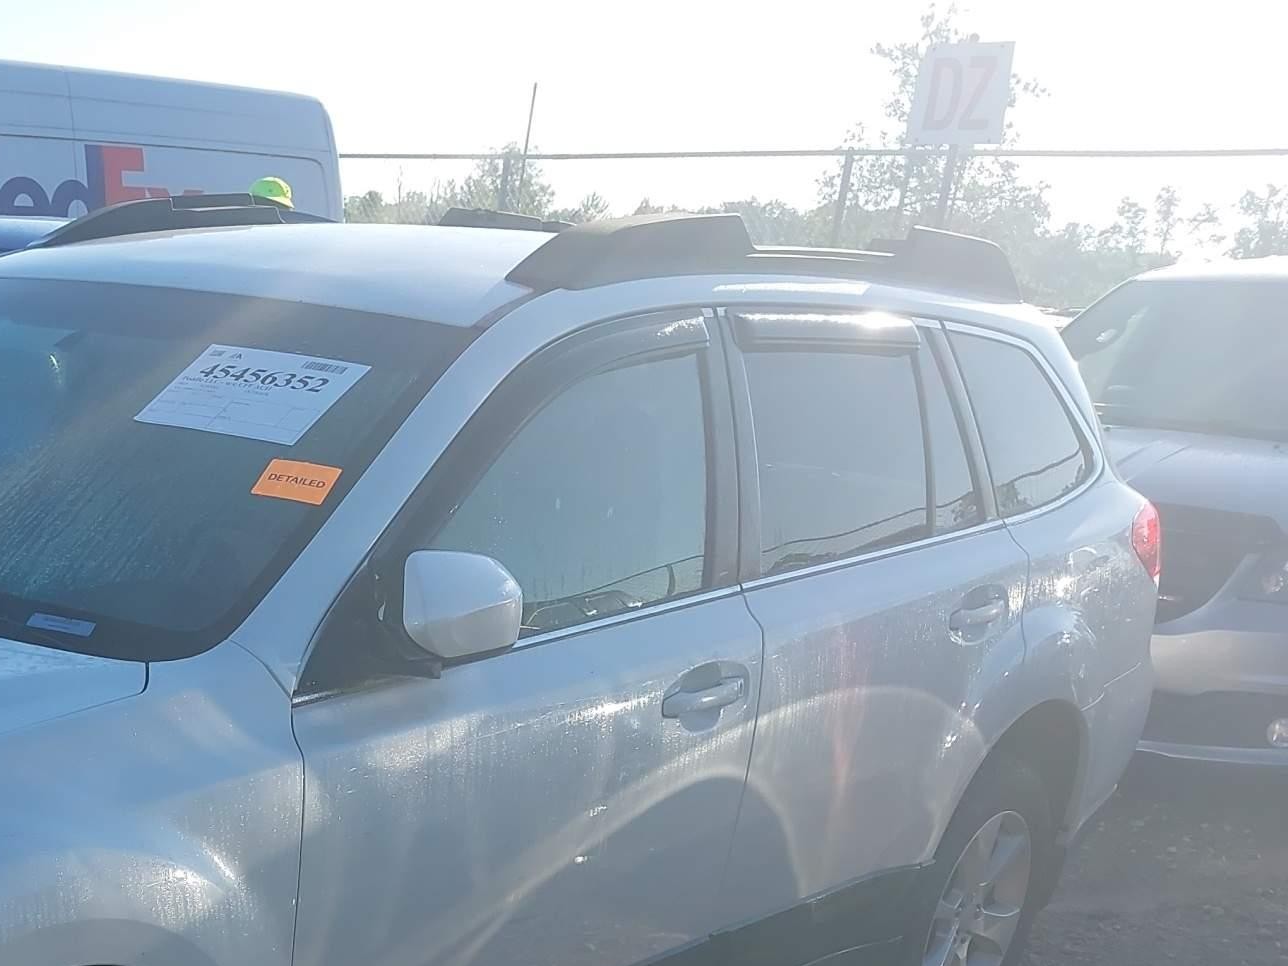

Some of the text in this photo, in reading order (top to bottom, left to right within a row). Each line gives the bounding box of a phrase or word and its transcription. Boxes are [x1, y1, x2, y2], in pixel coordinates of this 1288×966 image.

[921, 55, 998, 131] DZ
[200, 363, 330, 393] 45456352
[267, 473, 326, 489] DETAILED
